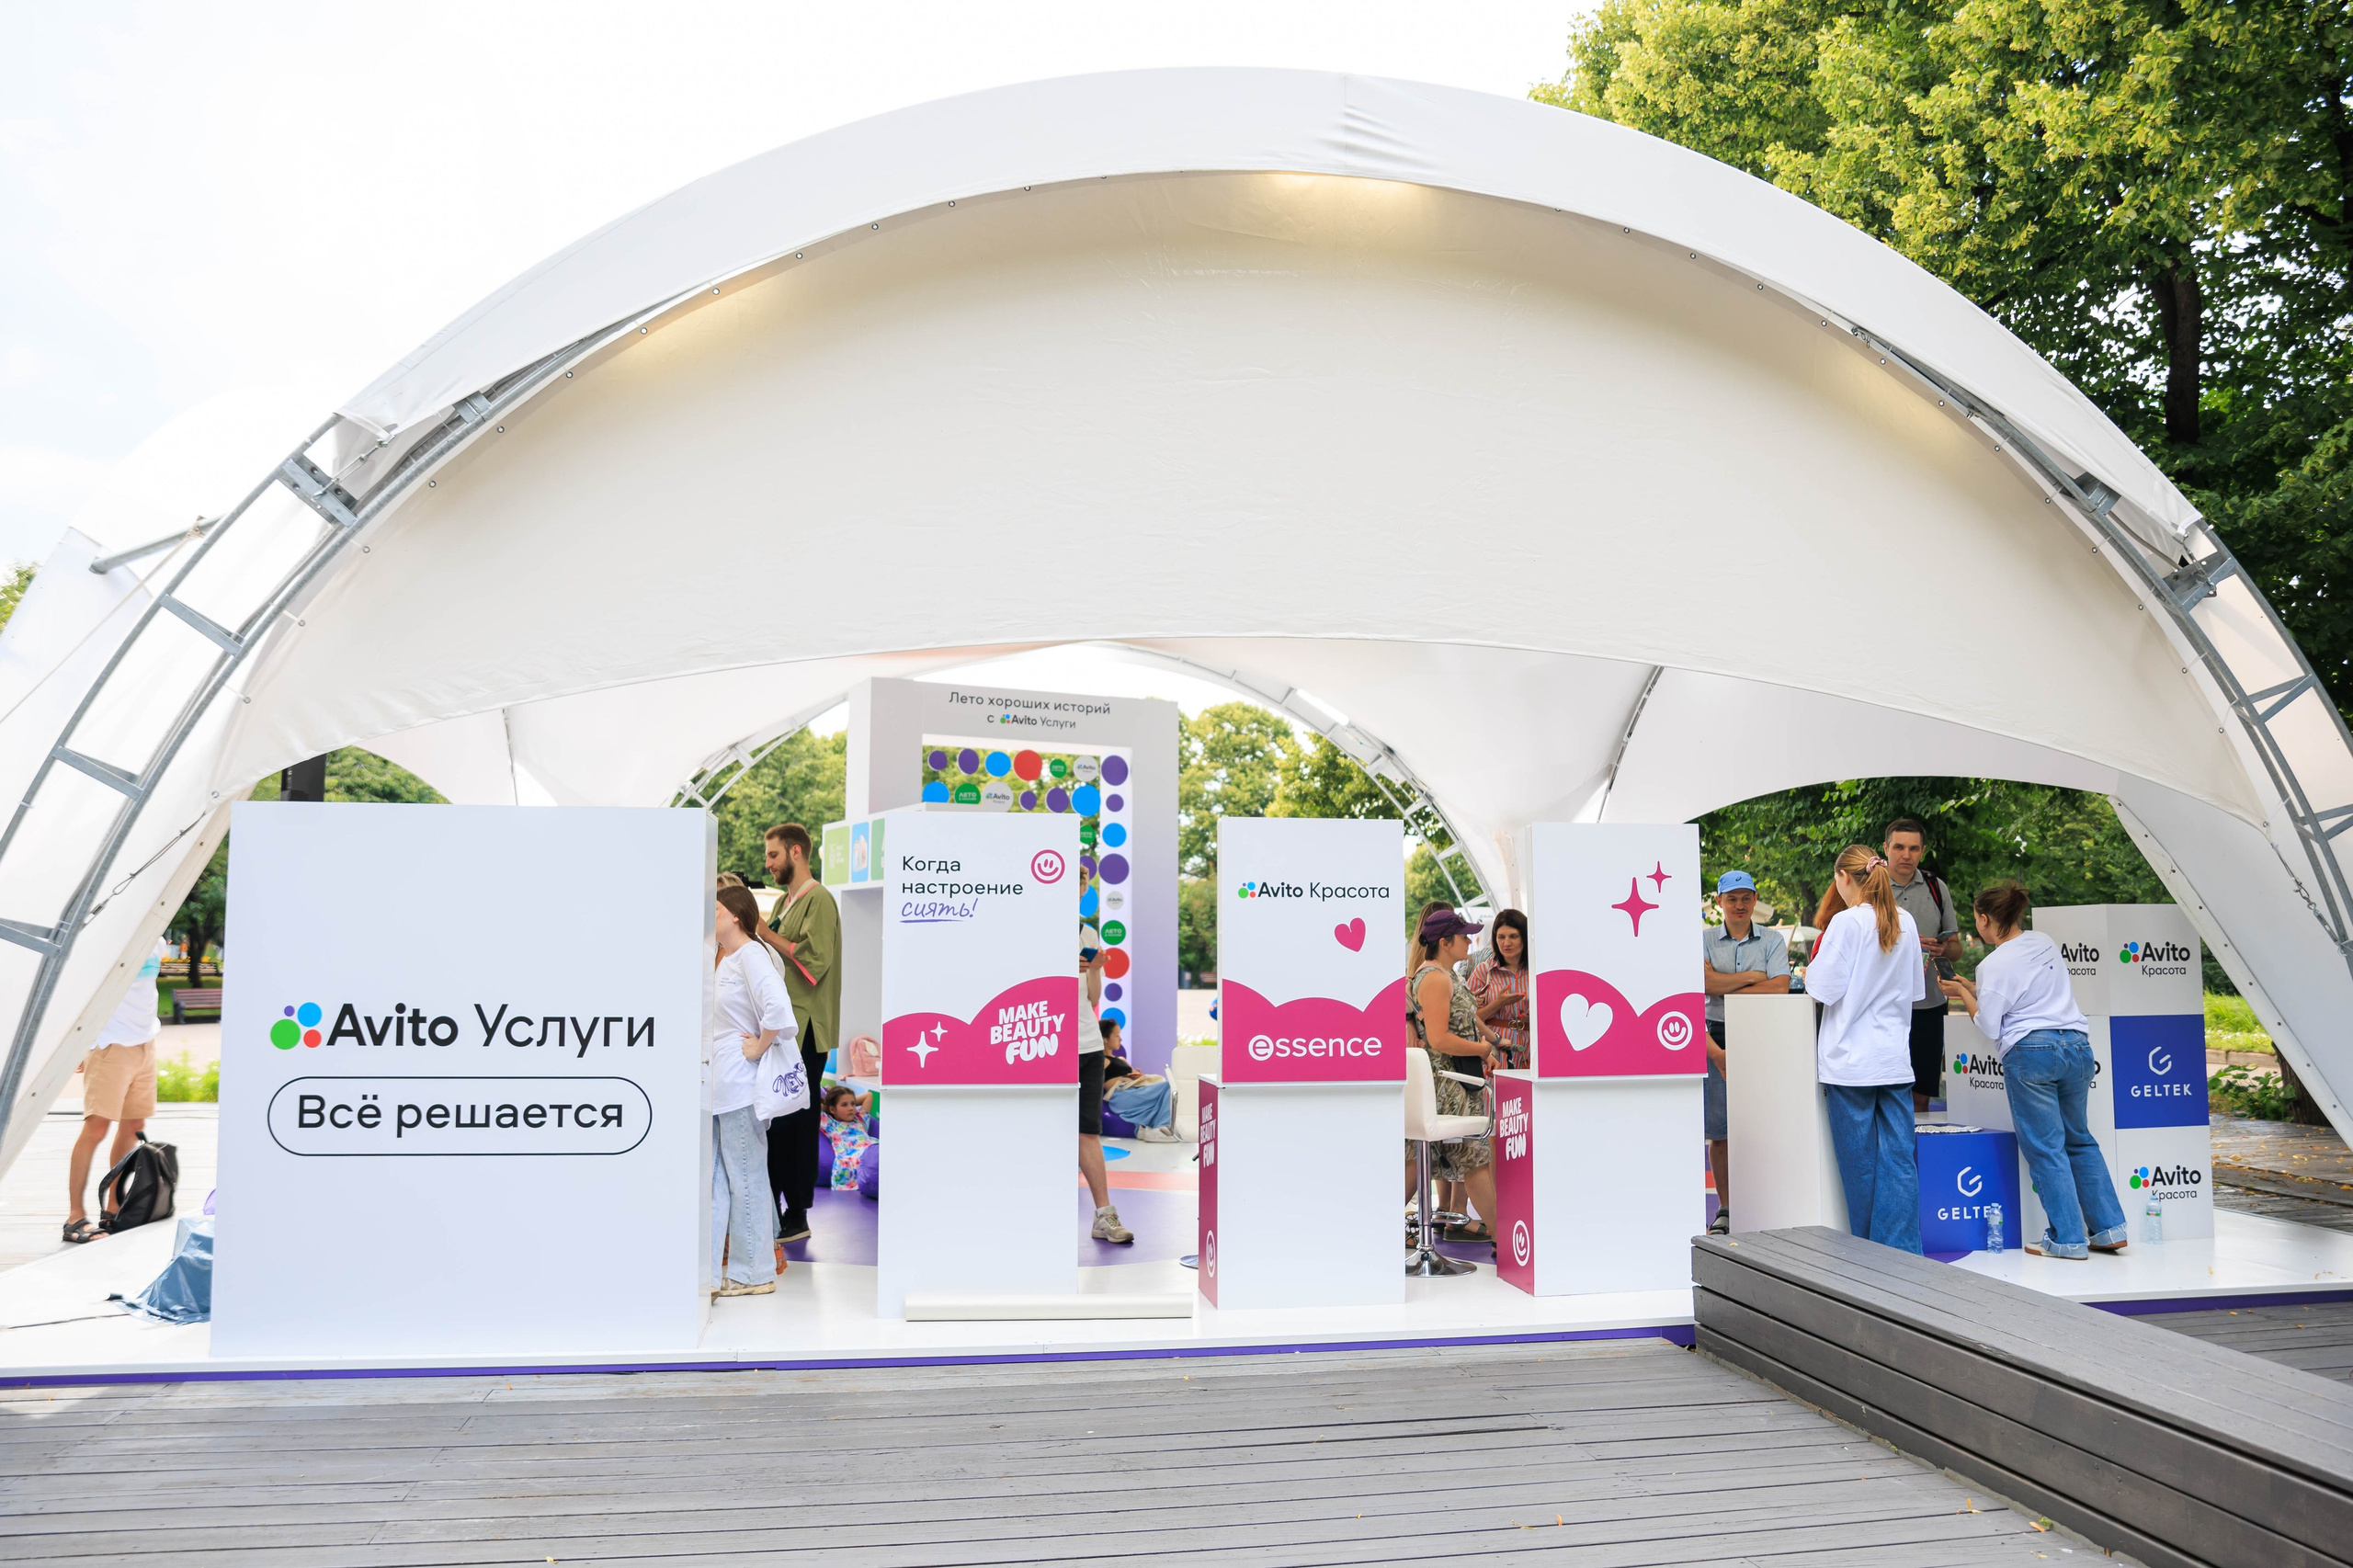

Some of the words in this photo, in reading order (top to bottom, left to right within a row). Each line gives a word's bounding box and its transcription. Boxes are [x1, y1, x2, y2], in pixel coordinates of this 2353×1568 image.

[949, 691, 984, 705] Лето
[987, 697, 1051, 710] хороших
[1053, 702, 1110, 716] историй
[1011, 714, 1038, 726] Avito
[1040, 716, 1076, 730] Услуги
[993, 792, 1010, 801] Avito
[902, 855, 961, 874] Когда
[902, 882, 1024, 899] настроение
[1257, 881, 1303, 898] Avito
[1310, 881, 1390, 902] Красота
[901, 897, 979, 918] сиять!
[2061, 941, 2100, 962] Avito
[2140, 940, 2191, 962] Avito
[2067, 967, 2097, 976] асота
[2142, 964, 2187, 978] Красота
[998, 1000, 1048, 1025] MAKE
[326, 1003, 459, 1047] Avito
[473, 1003, 655, 1058] Услуги
[990, 1013, 1066, 1045] BEAUTY
[1006, 1033, 1059, 1065] FUN
[1248, 1034, 1382, 1062] essence
[1969, 1053, 2005, 1077] Avito
[1969, 1076, 2005, 1090] Красота
[2131, 1084, 2192, 1097] GELTEK
[298, 1094, 382, 1129] Всё
[396, 1103, 623, 1139] решается
[1502, 1096, 1522, 1119] MAKE
[1499, 1111, 1529, 1138] BEAUTY
[1505, 1132, 1527, 1162] FUN
[2151, 1165, 2202, 1187] Avito
[1937, 1205, 2002, 1221] GELTE
